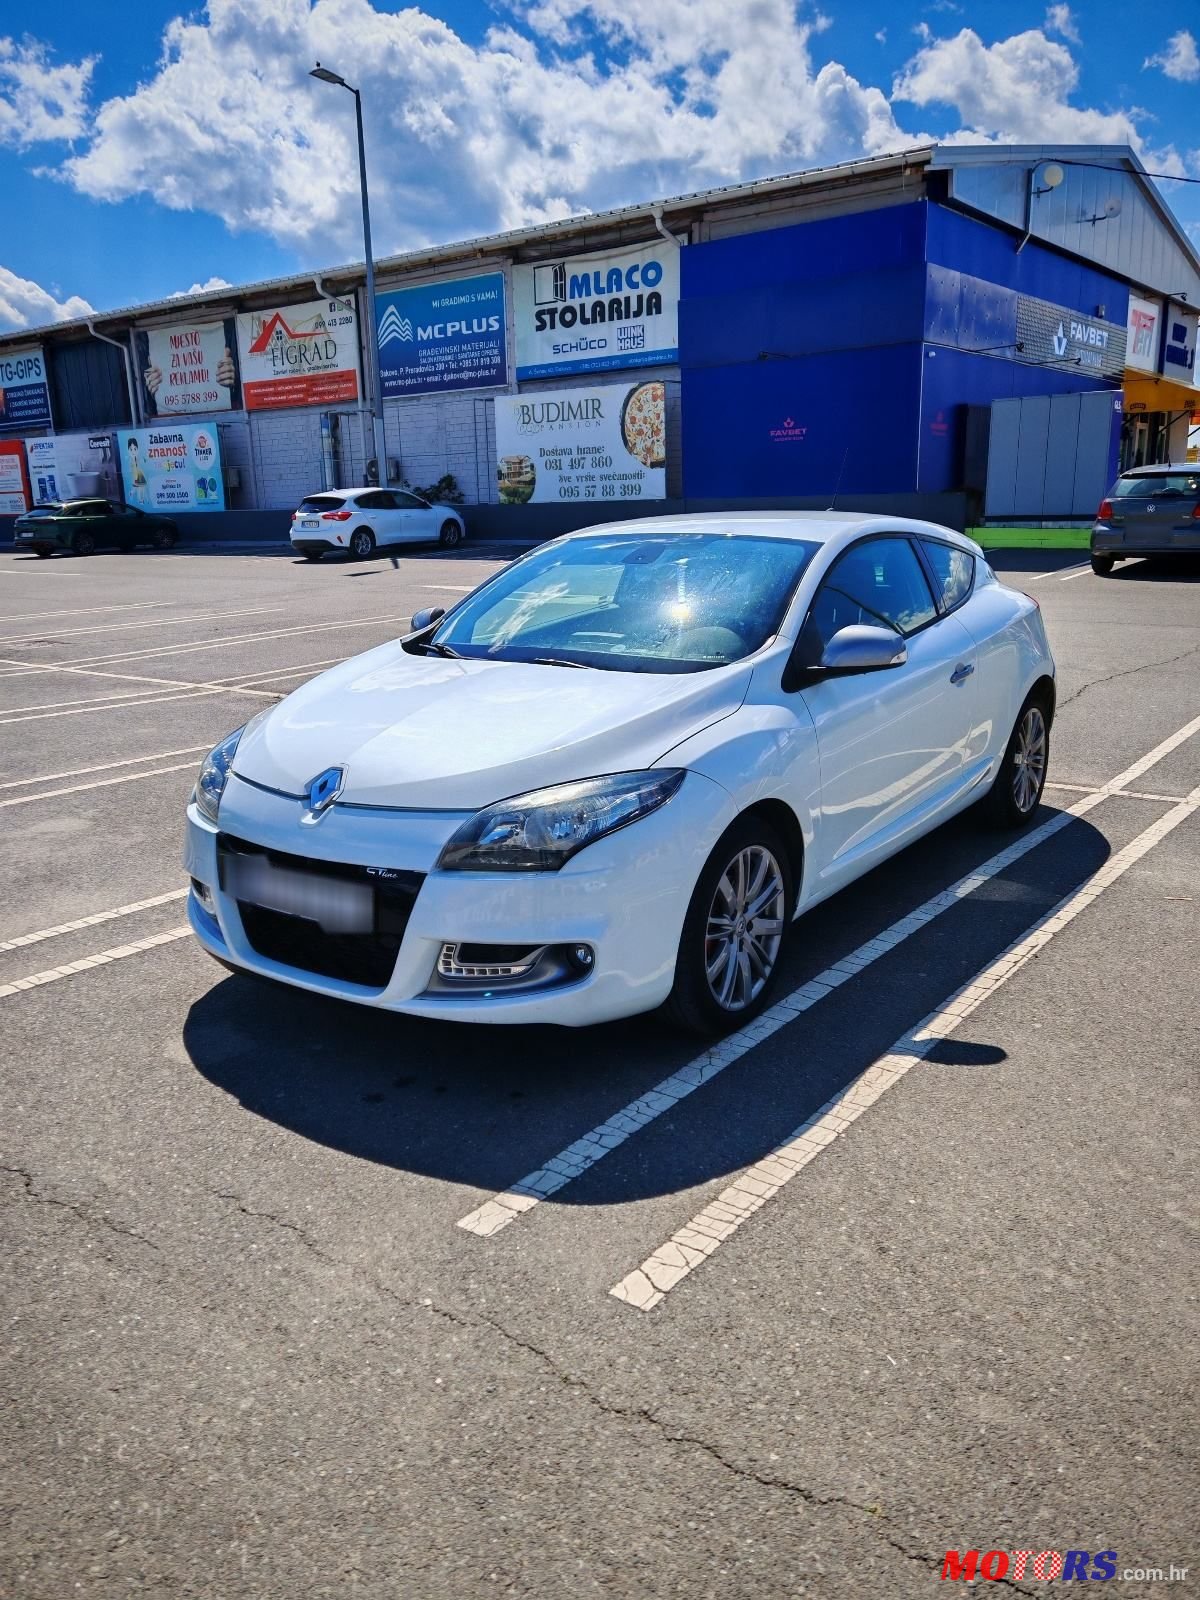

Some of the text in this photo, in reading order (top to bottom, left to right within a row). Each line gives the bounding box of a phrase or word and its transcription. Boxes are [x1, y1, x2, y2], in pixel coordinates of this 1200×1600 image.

[570, 260, 662, 300] MLACO
[432, 290, 498, 308] MI GRADIMO S VAMA!
[535, 292, 662, 332] STOLARIJA
[617, 326, 644, 338] WINK
[1070, 321, 1108, 348] FAVBET
[462, 340, 500, 351] MATERIJALI
[553, 337, 607, 354] SCHÜCO
[617, 337, 644, 350] HAUS
[272, 340, 337, 366] FIGRAD
[164, 391, 218, 405] 095 5788 399
[520, 398, 604, 425] BUDIMIR
[149, 433, 183, 444] Zabavna
[770, 428, 806, 437] FAVBET
[148, 443, 187, 458] znanost
[539, 445, 604, 457] Dostava hrane:
[544, 456, 613, 470] 031 497 860
[576, 472, 596, 482] vrste
[559, 483, 642, 498] 095 57 88 399
